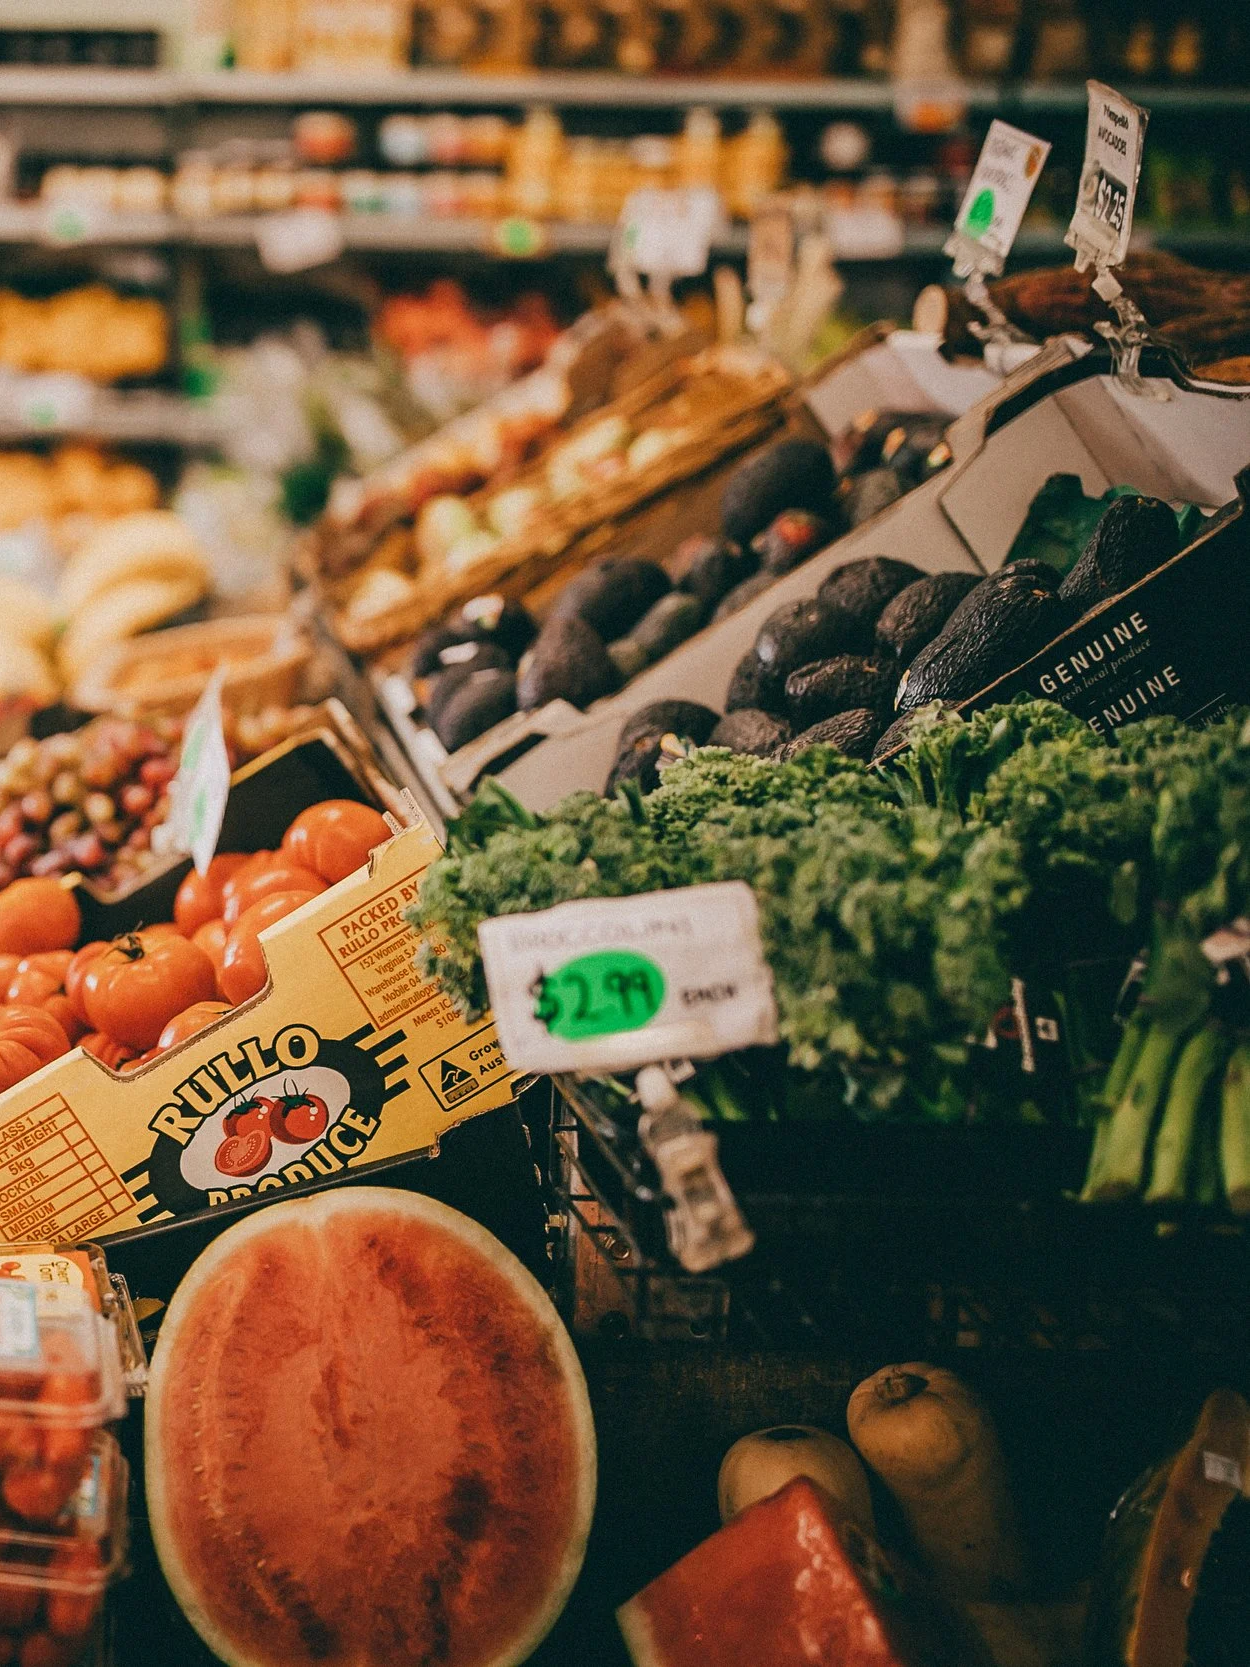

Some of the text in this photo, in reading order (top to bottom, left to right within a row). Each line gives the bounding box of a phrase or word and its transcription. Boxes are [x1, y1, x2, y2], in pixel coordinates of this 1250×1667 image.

[1039, 612, 1149, 694] GENUINE
[1088, 665, 1181, 736] ENUINE
[340, 896, 399, 939] PACKED
[400, 880, 420, 902] BY
[338, 928, 380, 959] RULLO
[359, 937, 407, 970] 152 Womma
[374, 953, 406, 975] Virginia
[364, 967, 410, 998] Warehouse
[382, 981, 410, 1004] Mobile
[412, 1006, 440, 1028] Meets
[469, 1038, 501, 1061] Grow
[479, 1052, 507, 1076] Aust
[150, 1026, 319, 1145] RULLO
[12, 1120, 60, 1154] WEIGHT
[8, 1156, 36, 1177] 5kg
[0, 1194, 41, 1223] SMALL
[9, 1201, 56, 1236] MEDIUM
[22, 1219, 60, 1241] ARGE
[66, 1209, 108, 1239] LARGE
